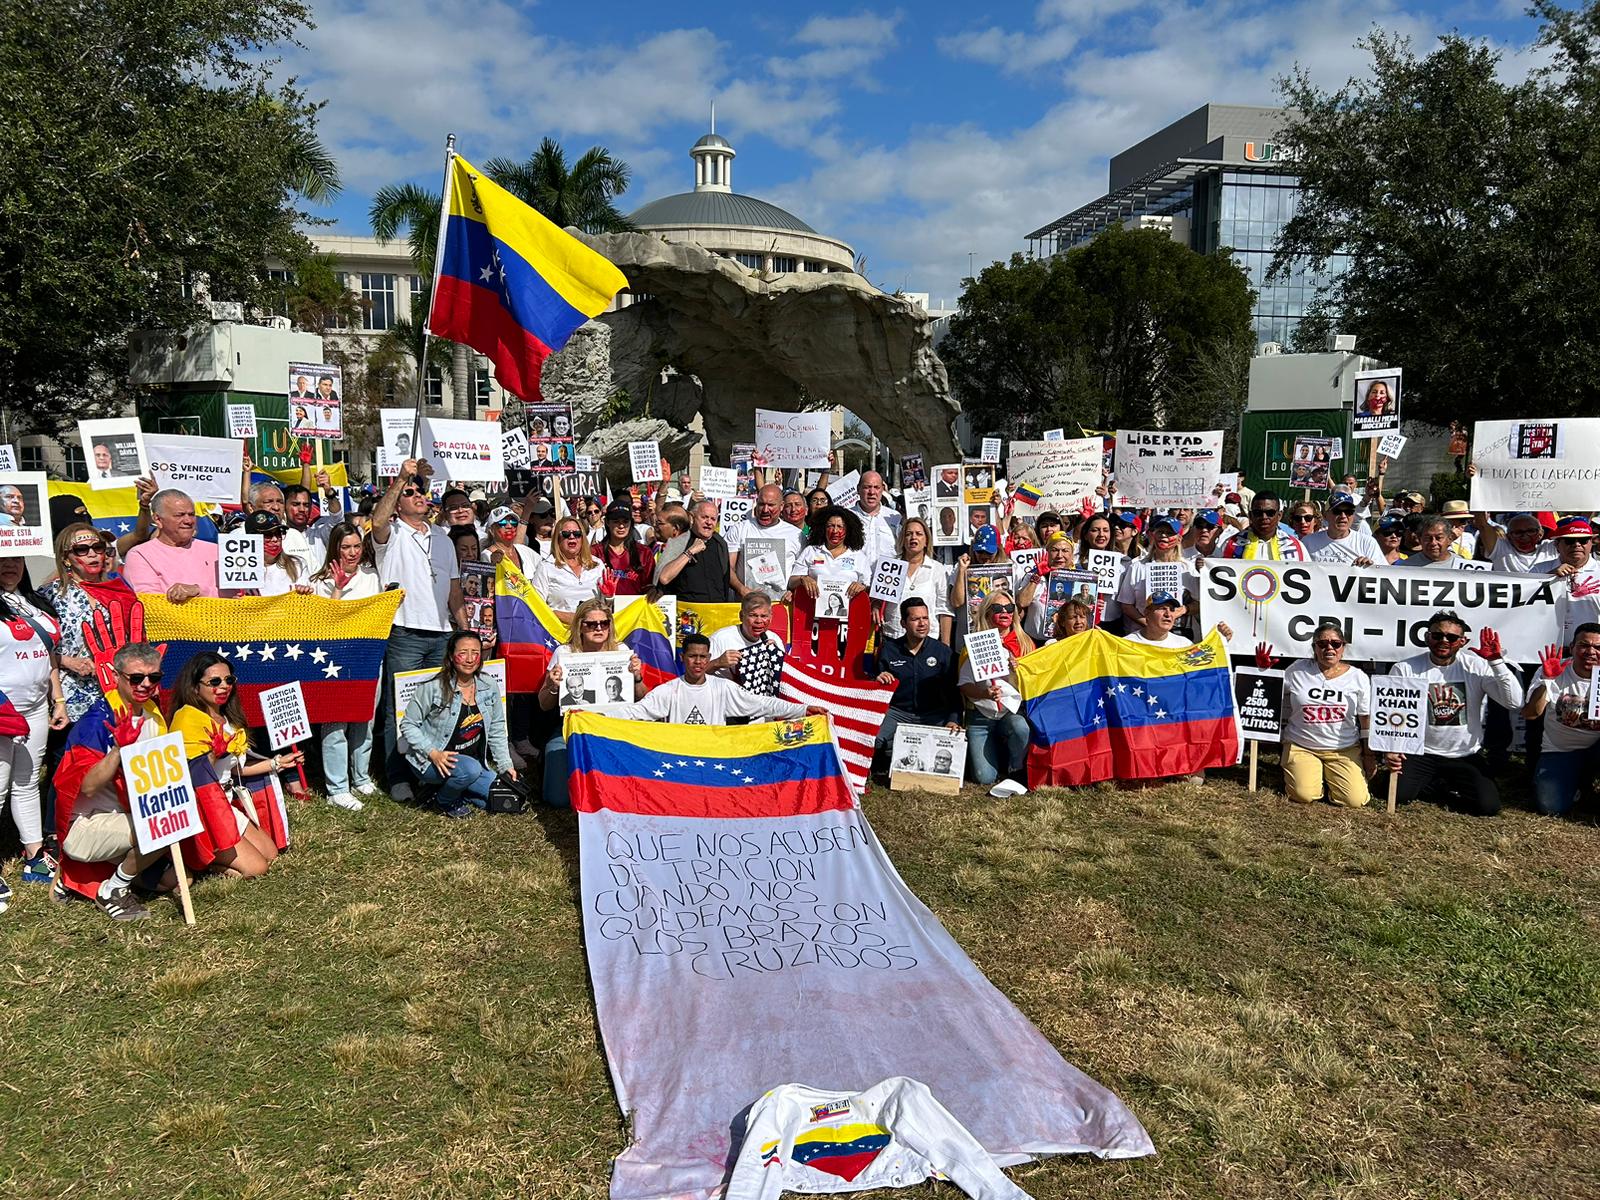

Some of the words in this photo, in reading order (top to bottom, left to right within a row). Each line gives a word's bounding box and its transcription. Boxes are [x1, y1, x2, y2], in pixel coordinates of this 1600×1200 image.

[262, 426, 301, 458] LUX
[432, 441, 447, 449] CPI
[448, 440, 477, 450] ACTÚA
[479, 443, 490, 451] YA
[1387, 435, 1402, 444] CPI
[433, 451, 452, 459] POR
[454, 452, 478, 460] VZLA
[502, 445, 526, 461] SOS
[151, 462, 178, 472] SOS
[180, 464, 231, 474] VENEZUELA
[1119, 459, 1145, 476] MÁS
[1152, 464, 1179, 473] NUNCA
[1480, 468, 1538, 480] EDUARDO
[196, 474, 213, 482] ICC
[637, 469, 658, 480] ¡YA!
[1512, 481, 1556, 490] DIPUTADO
[726, 500, 748, 511] ICC
[225, 540, 256, 553] CPI
[224, 556, 257, 568] SOS
[1016, 553, 1039, 565] CPI
[1094, 554, 1115, 567] CPI
[881, 561, 902, 575] CPI
[1092, 567, 1115, 578] SOS
[225, 572, 258, 581] VZLA
[877, 573, 900, 587] SOS
[875, 585, 897, 598] VZLA
[1098, 581, 1114, 589] ZLA
[1208, 565, 1311, 605] SOS
[1328, 574, 1555, 609] VENEZUELA
[1288, 614, 1353, 644] CPI
[969, 632, 995, 642] LIBERTAD
[970, 639, 997, 648] LIBERTAD
[972, 645, 998, 655] LIBERTAD
[974, 650, 1000, 660] LIBERTAD
[975, 656, 1001, 666] LIBERTAD
[977, 662, 1004, 679] ¡YA!
[266, 687, 296, 701] JUSTICIA
[1253, 688, 1265, 698] DE
[1308, 687, 1343, 702] CPI
[1376, 687, 1420, 699] KARIM
[268, 694, 298, 708] JUSTICIA
[1245, 697, 1269, 707] 2500
[1378, 699, 1418, 710] KHAN
[270, 701, 299, 715] JUSTICIA
[1240, 706, 1275, 718] PRESOS
[1302, 706, 1346, 722] SOS
[271, 708, 301, 722] JUSTICIA
[1375, 711, 1419, 728] SOS
[273, 715, 302, 729] JUSTICIA
[1240, 717, 1279, 730] OLÍTICOS
[275, 721, 306, 746] ¡YA!
[1375, 729, 1418, 739] VENEZUELA
[129, 744, 184, 794] SOS
[137, 784, 190, 819] Karim
[147, 808, 190, 841] Kahn
[606, 831, 682, 862] QUE
[696, 831, 763, 858] NOS
[770, 824, 869, 856] ACUSEN
[608, 861, 643, 887] DE
[595, 881, 730, 915] CUANDO
[749, 881, 819, 903] NOS
[600, 901, 800, 941] QUEDEMOS
[813, 901, 887, 924] CON
[632, 929, 708, 956] LOS
[723, 921, 886, 950] BRAZOS
[692, 942, 918, 980] CRUZADOS
